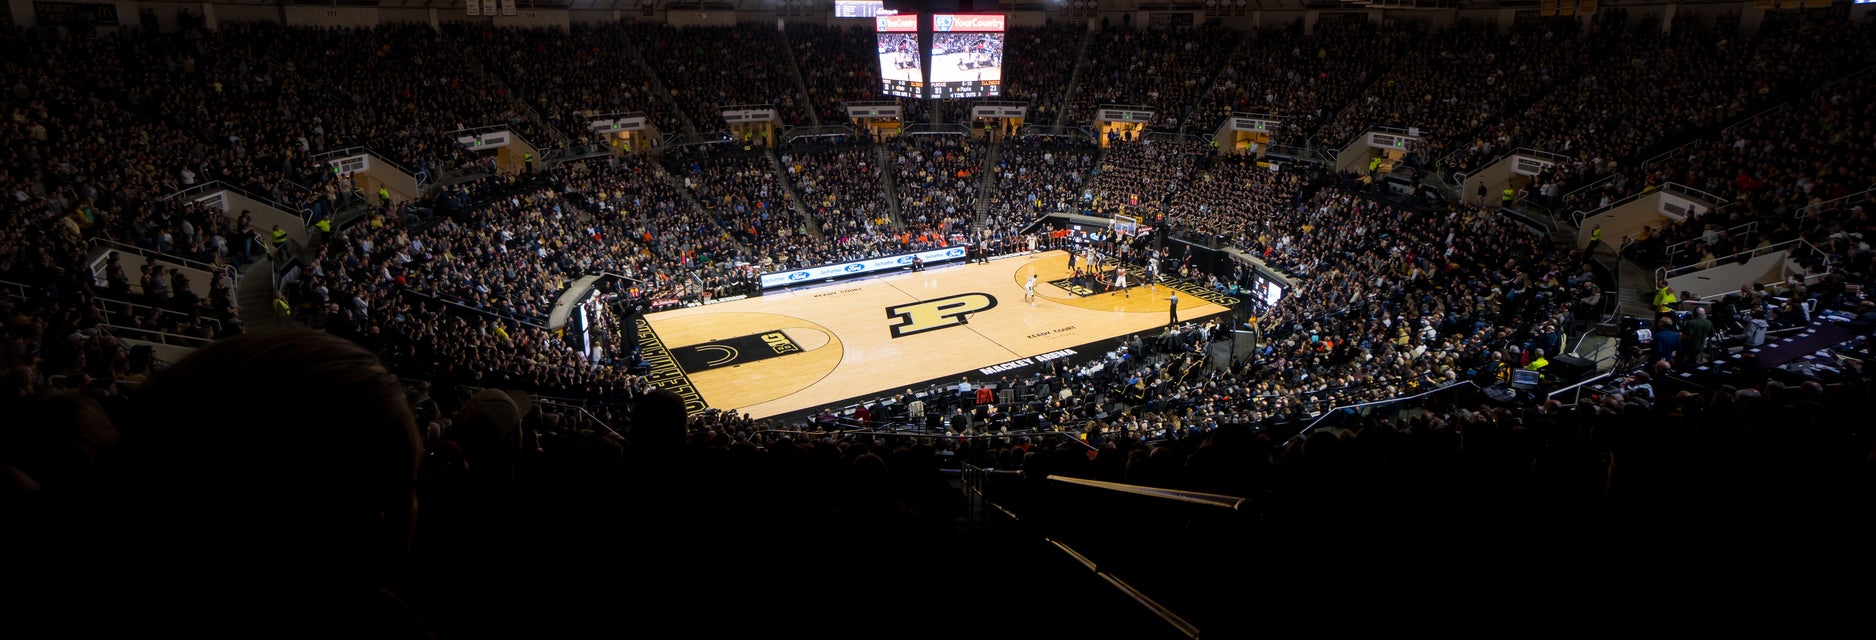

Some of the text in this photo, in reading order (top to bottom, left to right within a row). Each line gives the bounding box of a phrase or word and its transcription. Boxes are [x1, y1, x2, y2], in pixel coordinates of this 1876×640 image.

[954, 16, 1003, 30] YourCountry
[885, 292, 999, 340] P
[979, 348, 1078, 376] MACKEY ARENA
